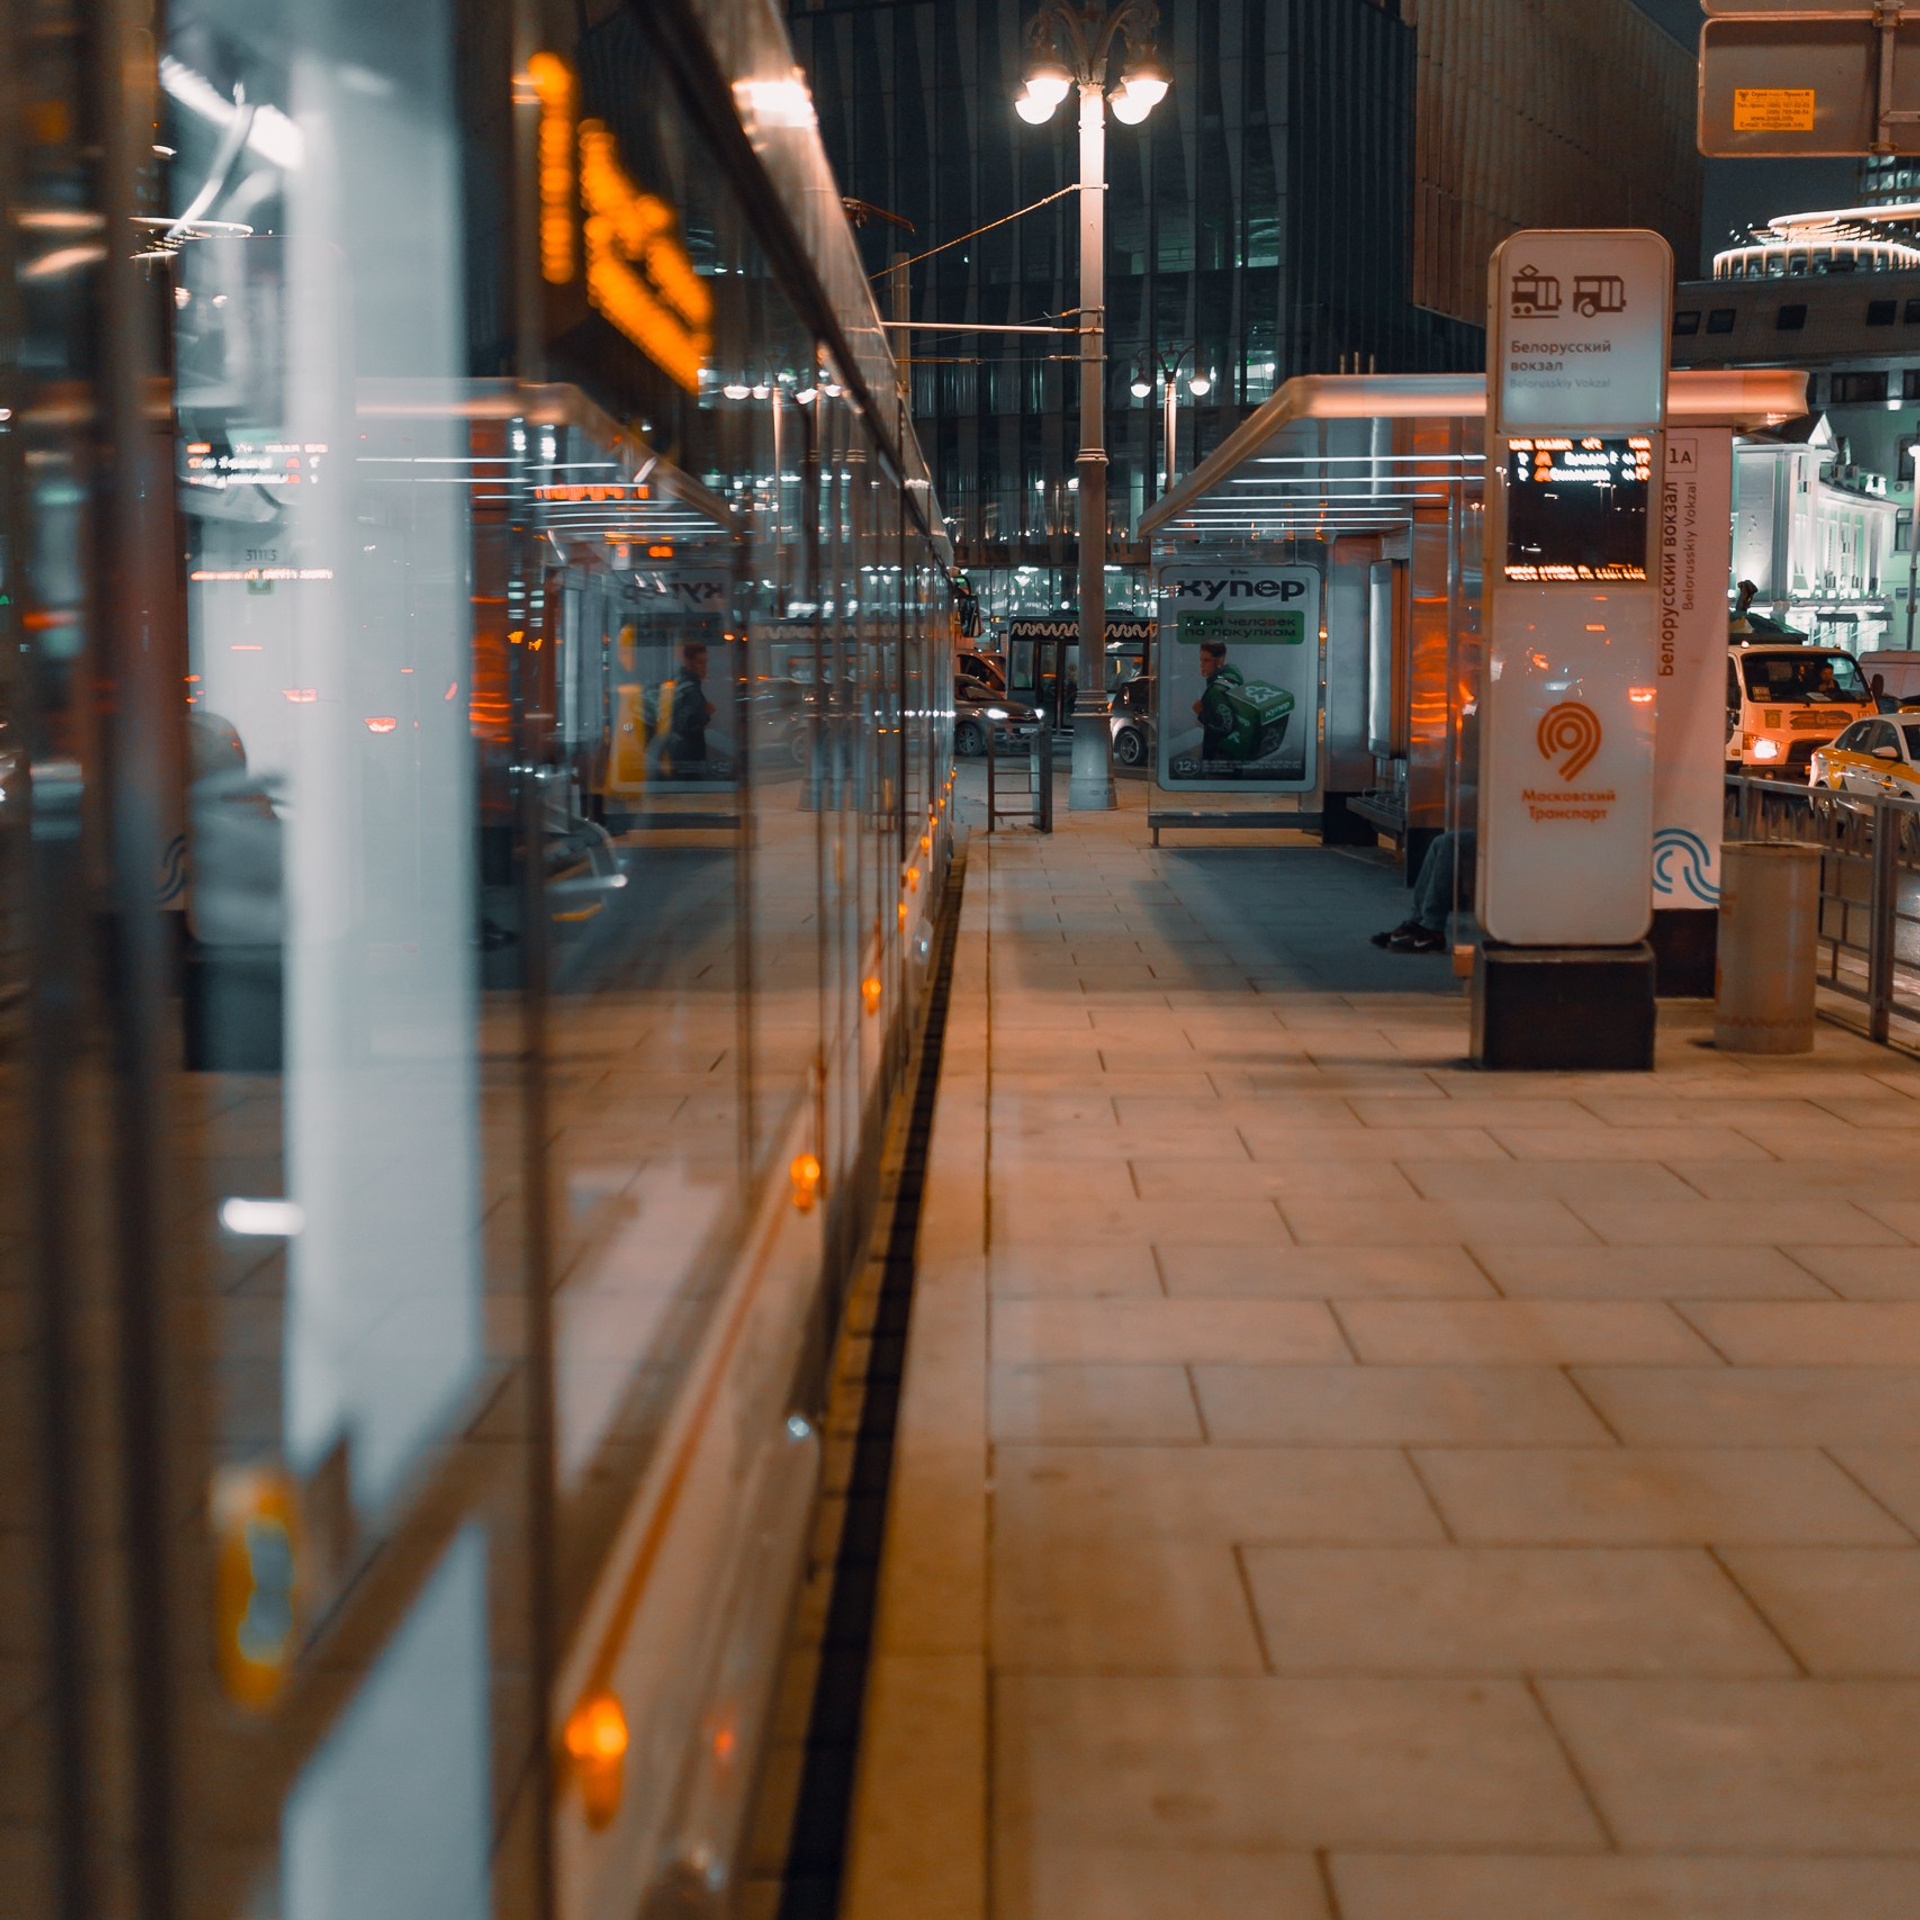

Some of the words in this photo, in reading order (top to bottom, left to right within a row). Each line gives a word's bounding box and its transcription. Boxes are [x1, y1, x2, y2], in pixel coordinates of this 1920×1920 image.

[1511, 340, 1611, 356] Белорусский
[1510, 361, 1563, 372] вокзал
[1683, 481, 1697, 527] Vokzal
[1663, 481, 1678, 547] вокзал
[1682, 538, 1698, 611] Belorusskiy
[1177, 579, 1305, 602] купер
[1183, 615, 1223, 627] Твой
[1226, 617, 1296, 627] человек
[1185, 628, 1205, 637] по
[1211, 628, 1296, 639] покупкам
[1177, 760, 1199, 771] 12+
[1522, 788, 1616, 803] Московский
[1528, 806, 1608, 822] Транспорт
